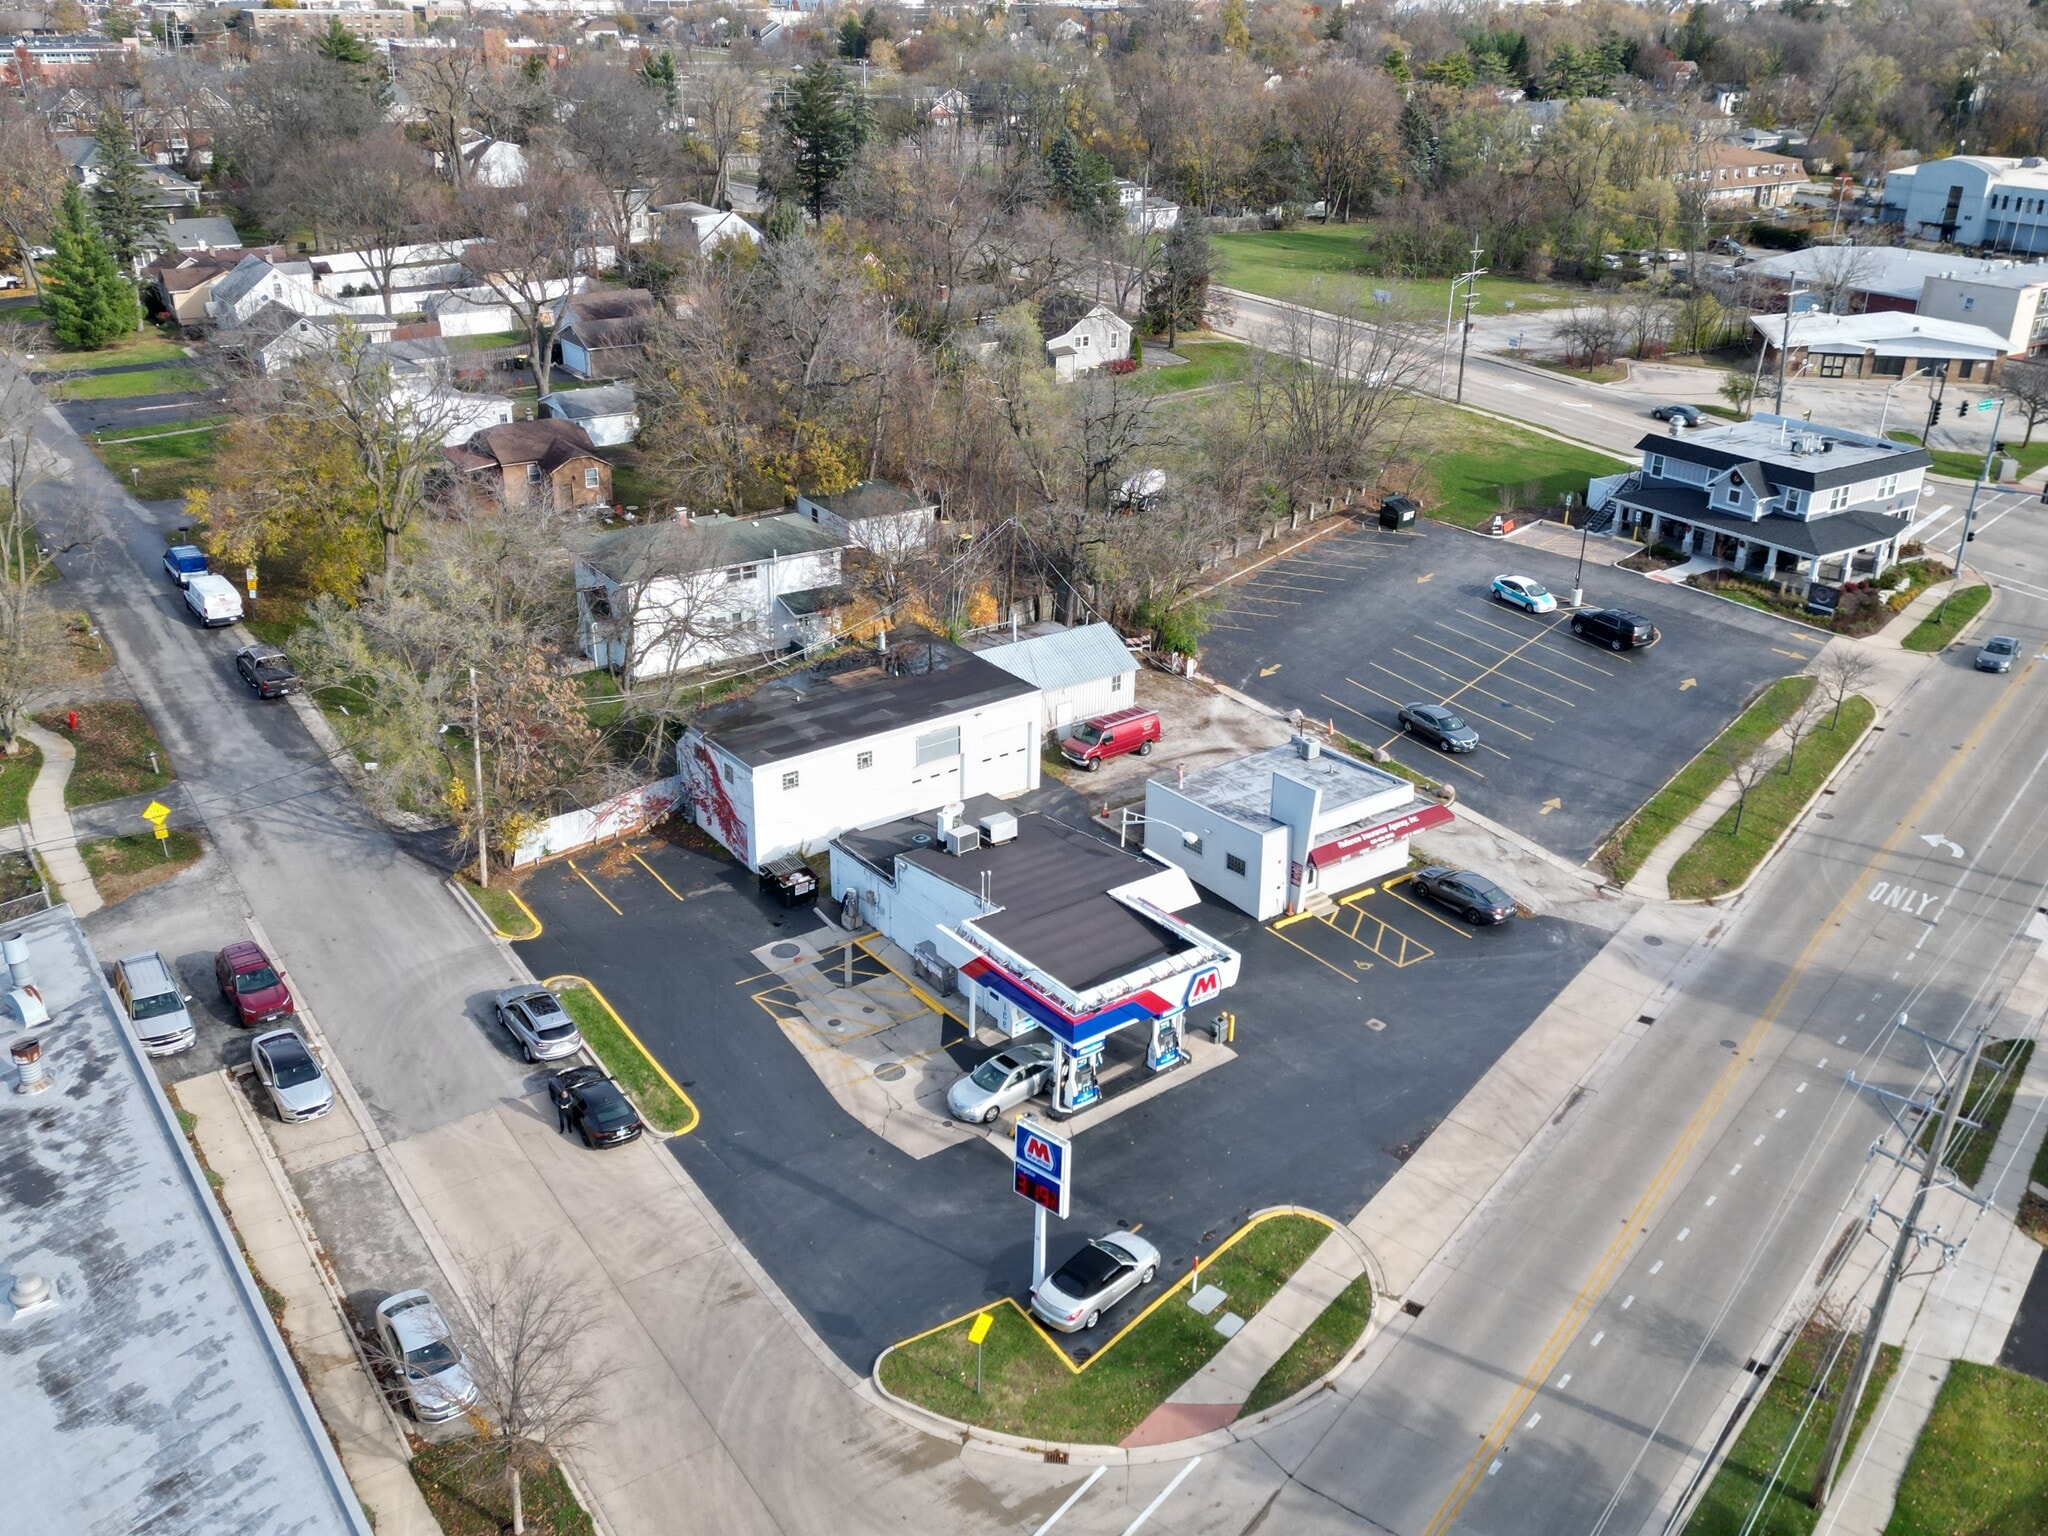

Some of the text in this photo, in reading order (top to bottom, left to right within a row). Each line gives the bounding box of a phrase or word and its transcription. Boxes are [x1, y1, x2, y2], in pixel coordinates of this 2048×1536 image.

[1337, 836, 1361, 848] Reliance
[1362, 827, 1388, 840] Insurance
[1389, 819, 1410, 831] Agency,
[1867, 881, 1939, 916] ONLY
[1193, 973, 1217, 997] M
[1028, 1138, 1050, 1164] M
